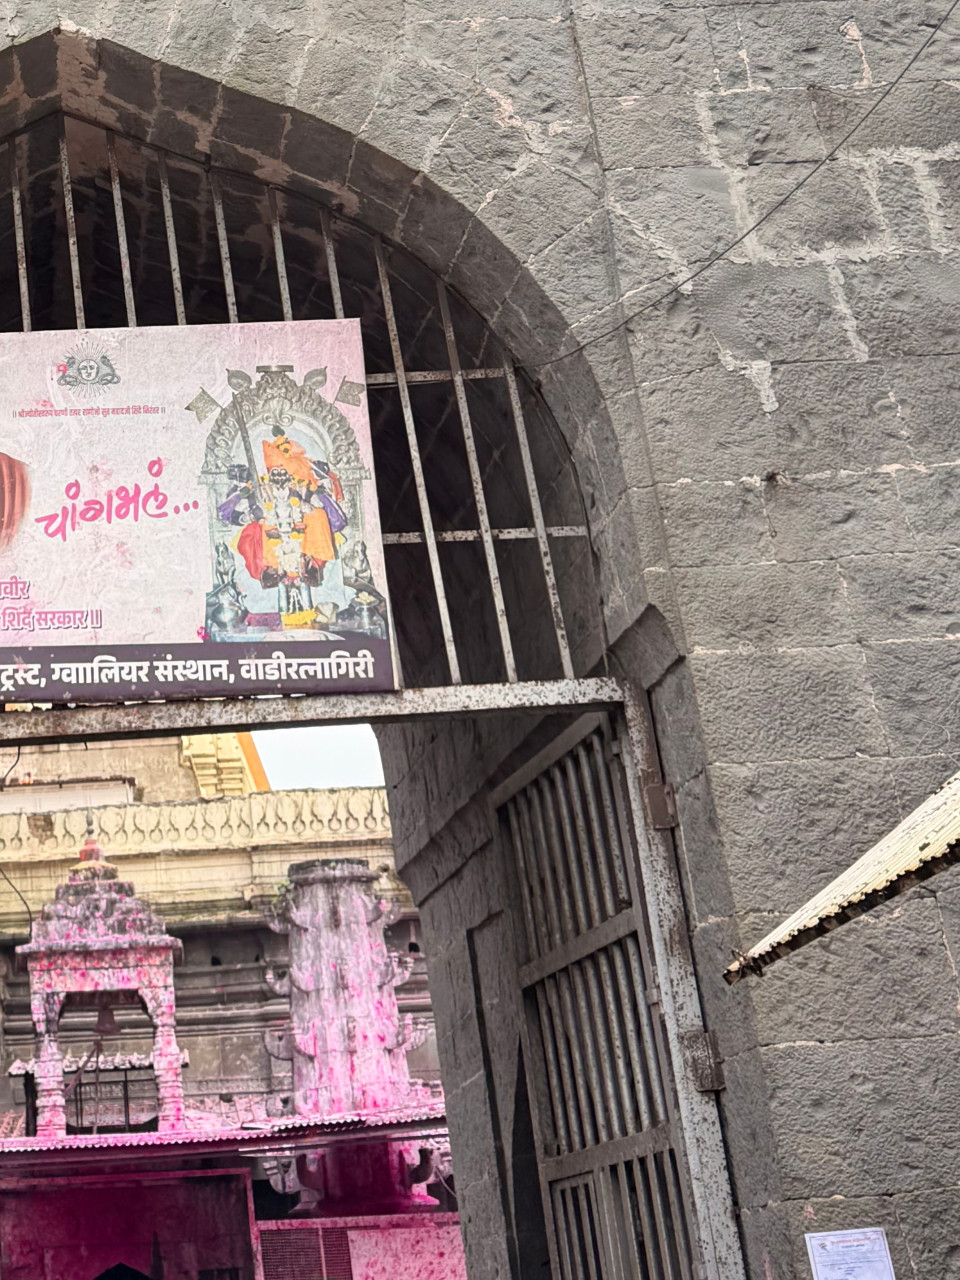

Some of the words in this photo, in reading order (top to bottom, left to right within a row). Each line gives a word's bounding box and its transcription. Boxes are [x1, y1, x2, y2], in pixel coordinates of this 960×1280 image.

[1, 606, 34, 631] शिंदे
[35, 609, 88, 629] सरकार
[0, 663, 47, 691] ट्रस्ट,
[153, 654, 235, 683] संस्थान,
[238, 650, 375, 680] वाडीरत्नागिरी
